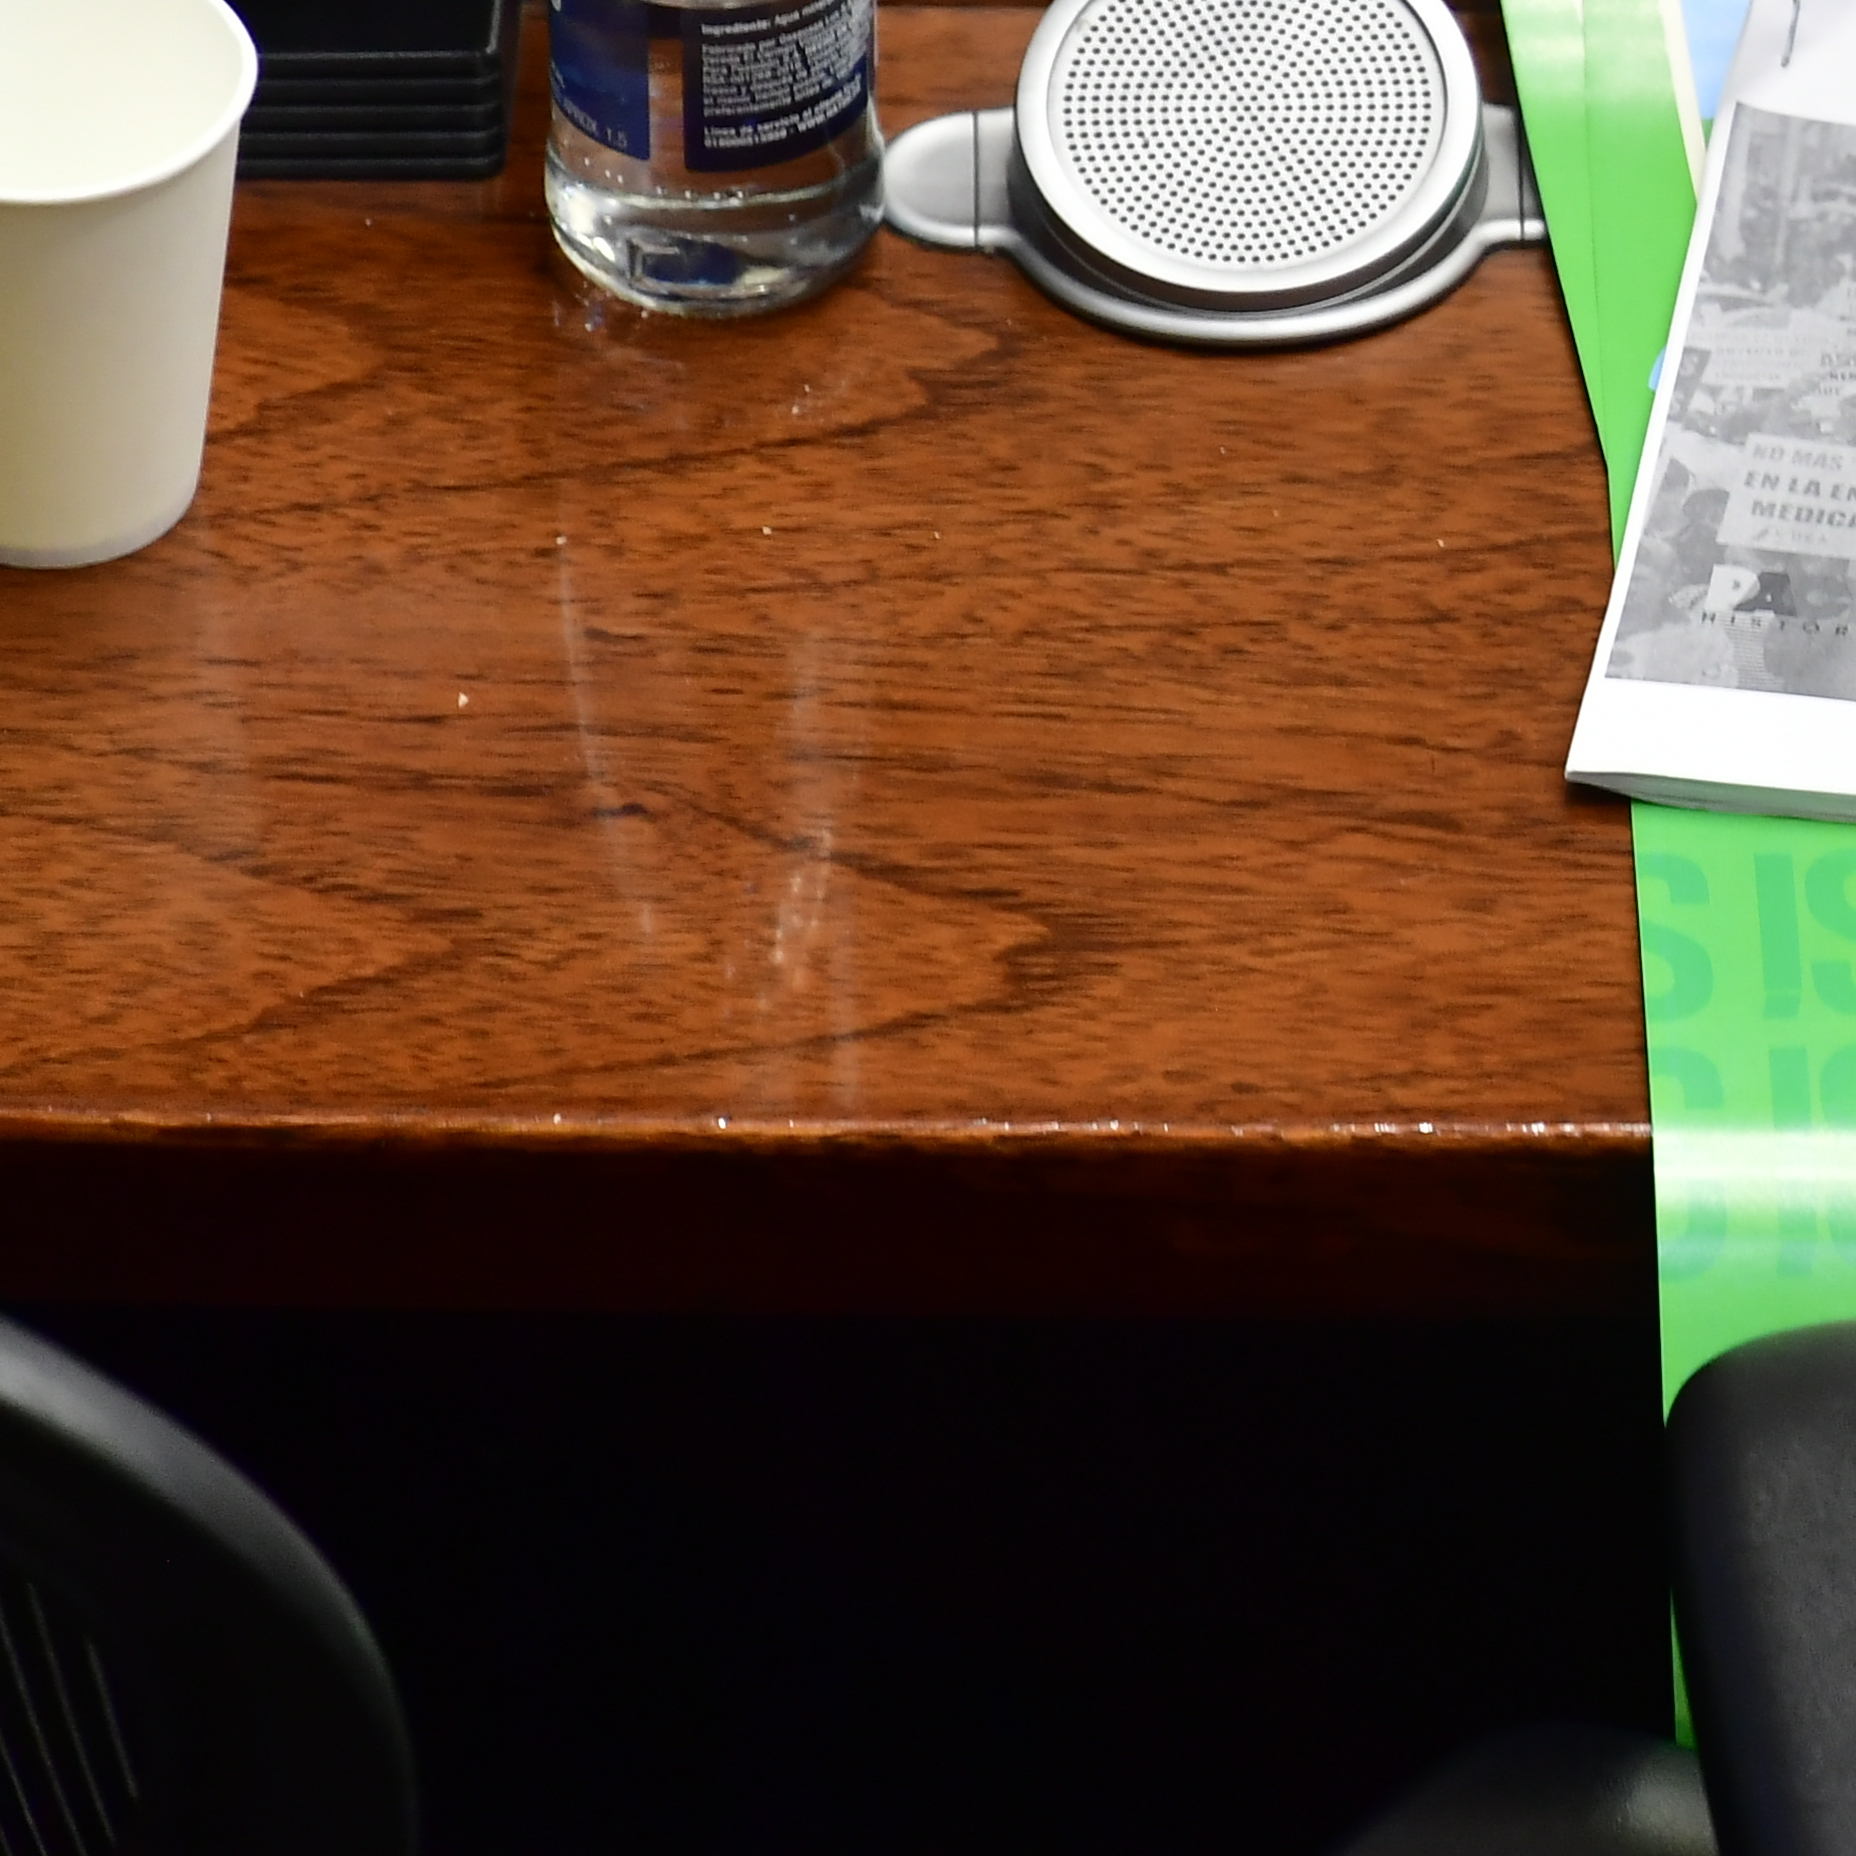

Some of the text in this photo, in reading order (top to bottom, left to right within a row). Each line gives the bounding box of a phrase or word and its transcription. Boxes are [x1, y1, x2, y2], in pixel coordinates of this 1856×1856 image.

[1752, 442, 1784, 462] NO
[1743, 469, 1781, 491] EN
[1787, 475, 1822, 498] LA
